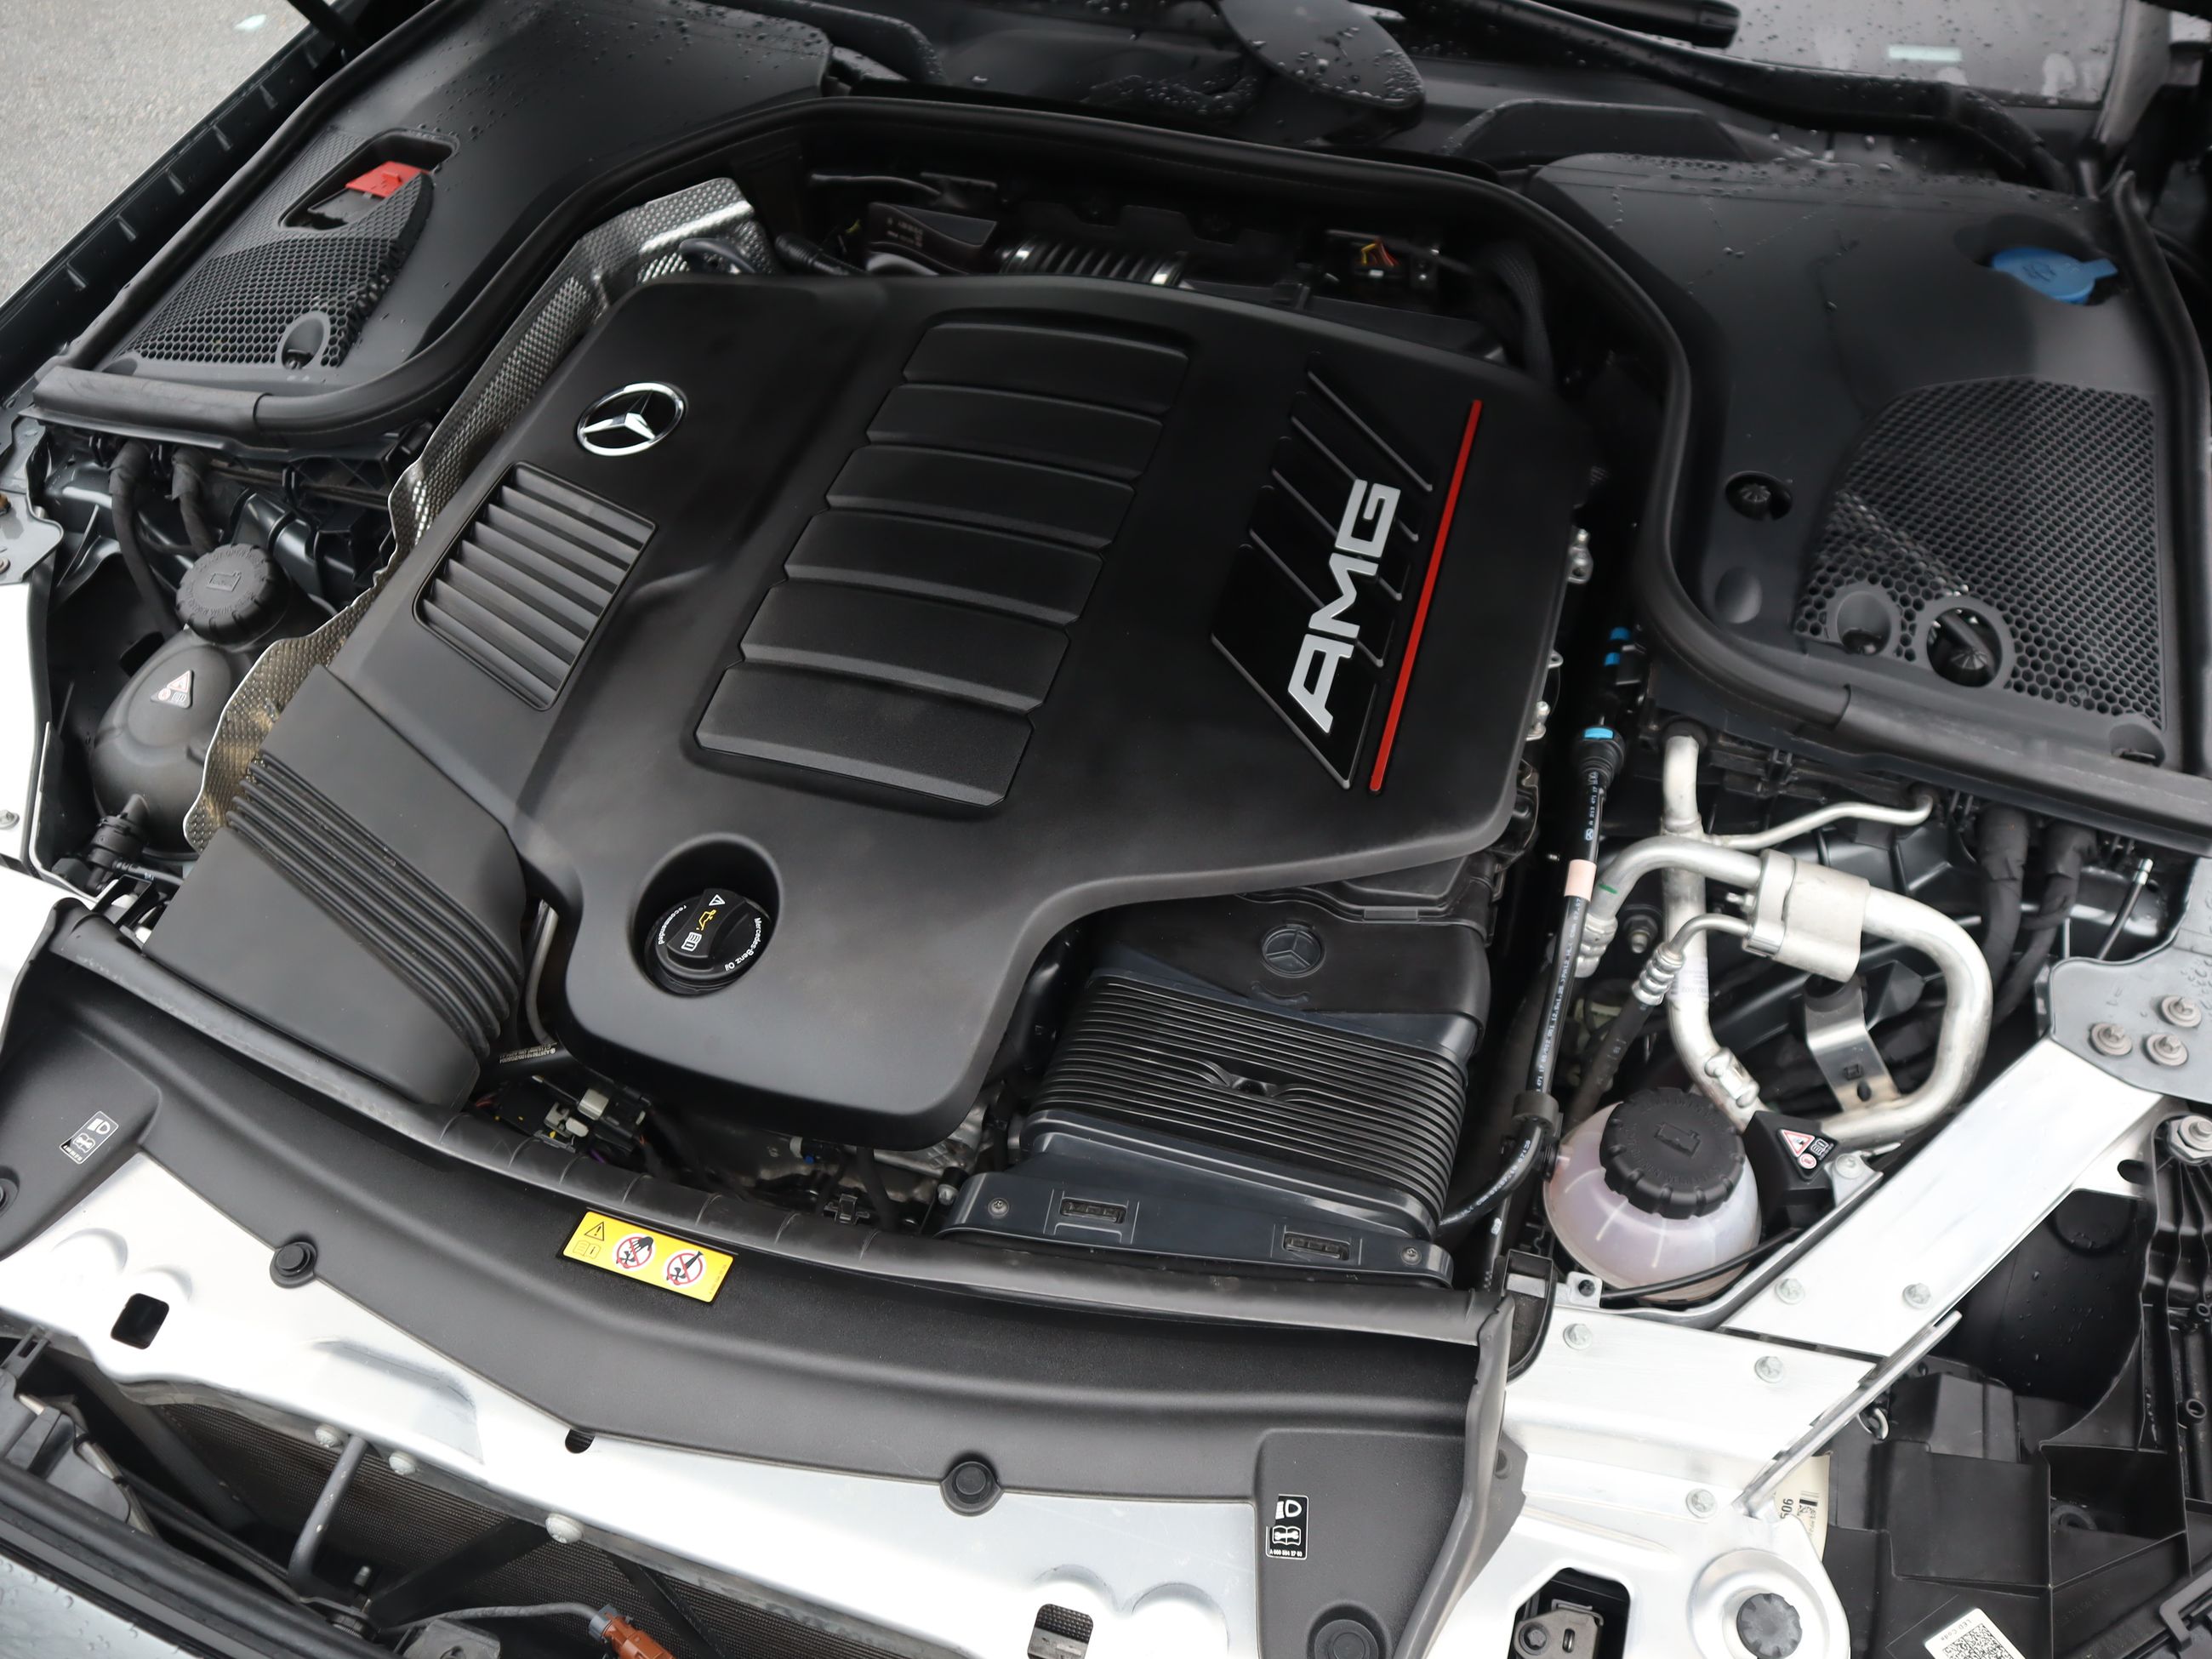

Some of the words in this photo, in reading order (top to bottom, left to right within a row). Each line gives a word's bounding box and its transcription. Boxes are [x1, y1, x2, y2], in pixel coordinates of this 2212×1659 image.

[1288, 478, 1401, 735] AMG
[658, 905, 687, 945] recommended
[735, 917, 763, 965] Mercedes-Benz
[725, 962, 735, 972] Oil
[1959, 1618, 1973, 1631] LED
